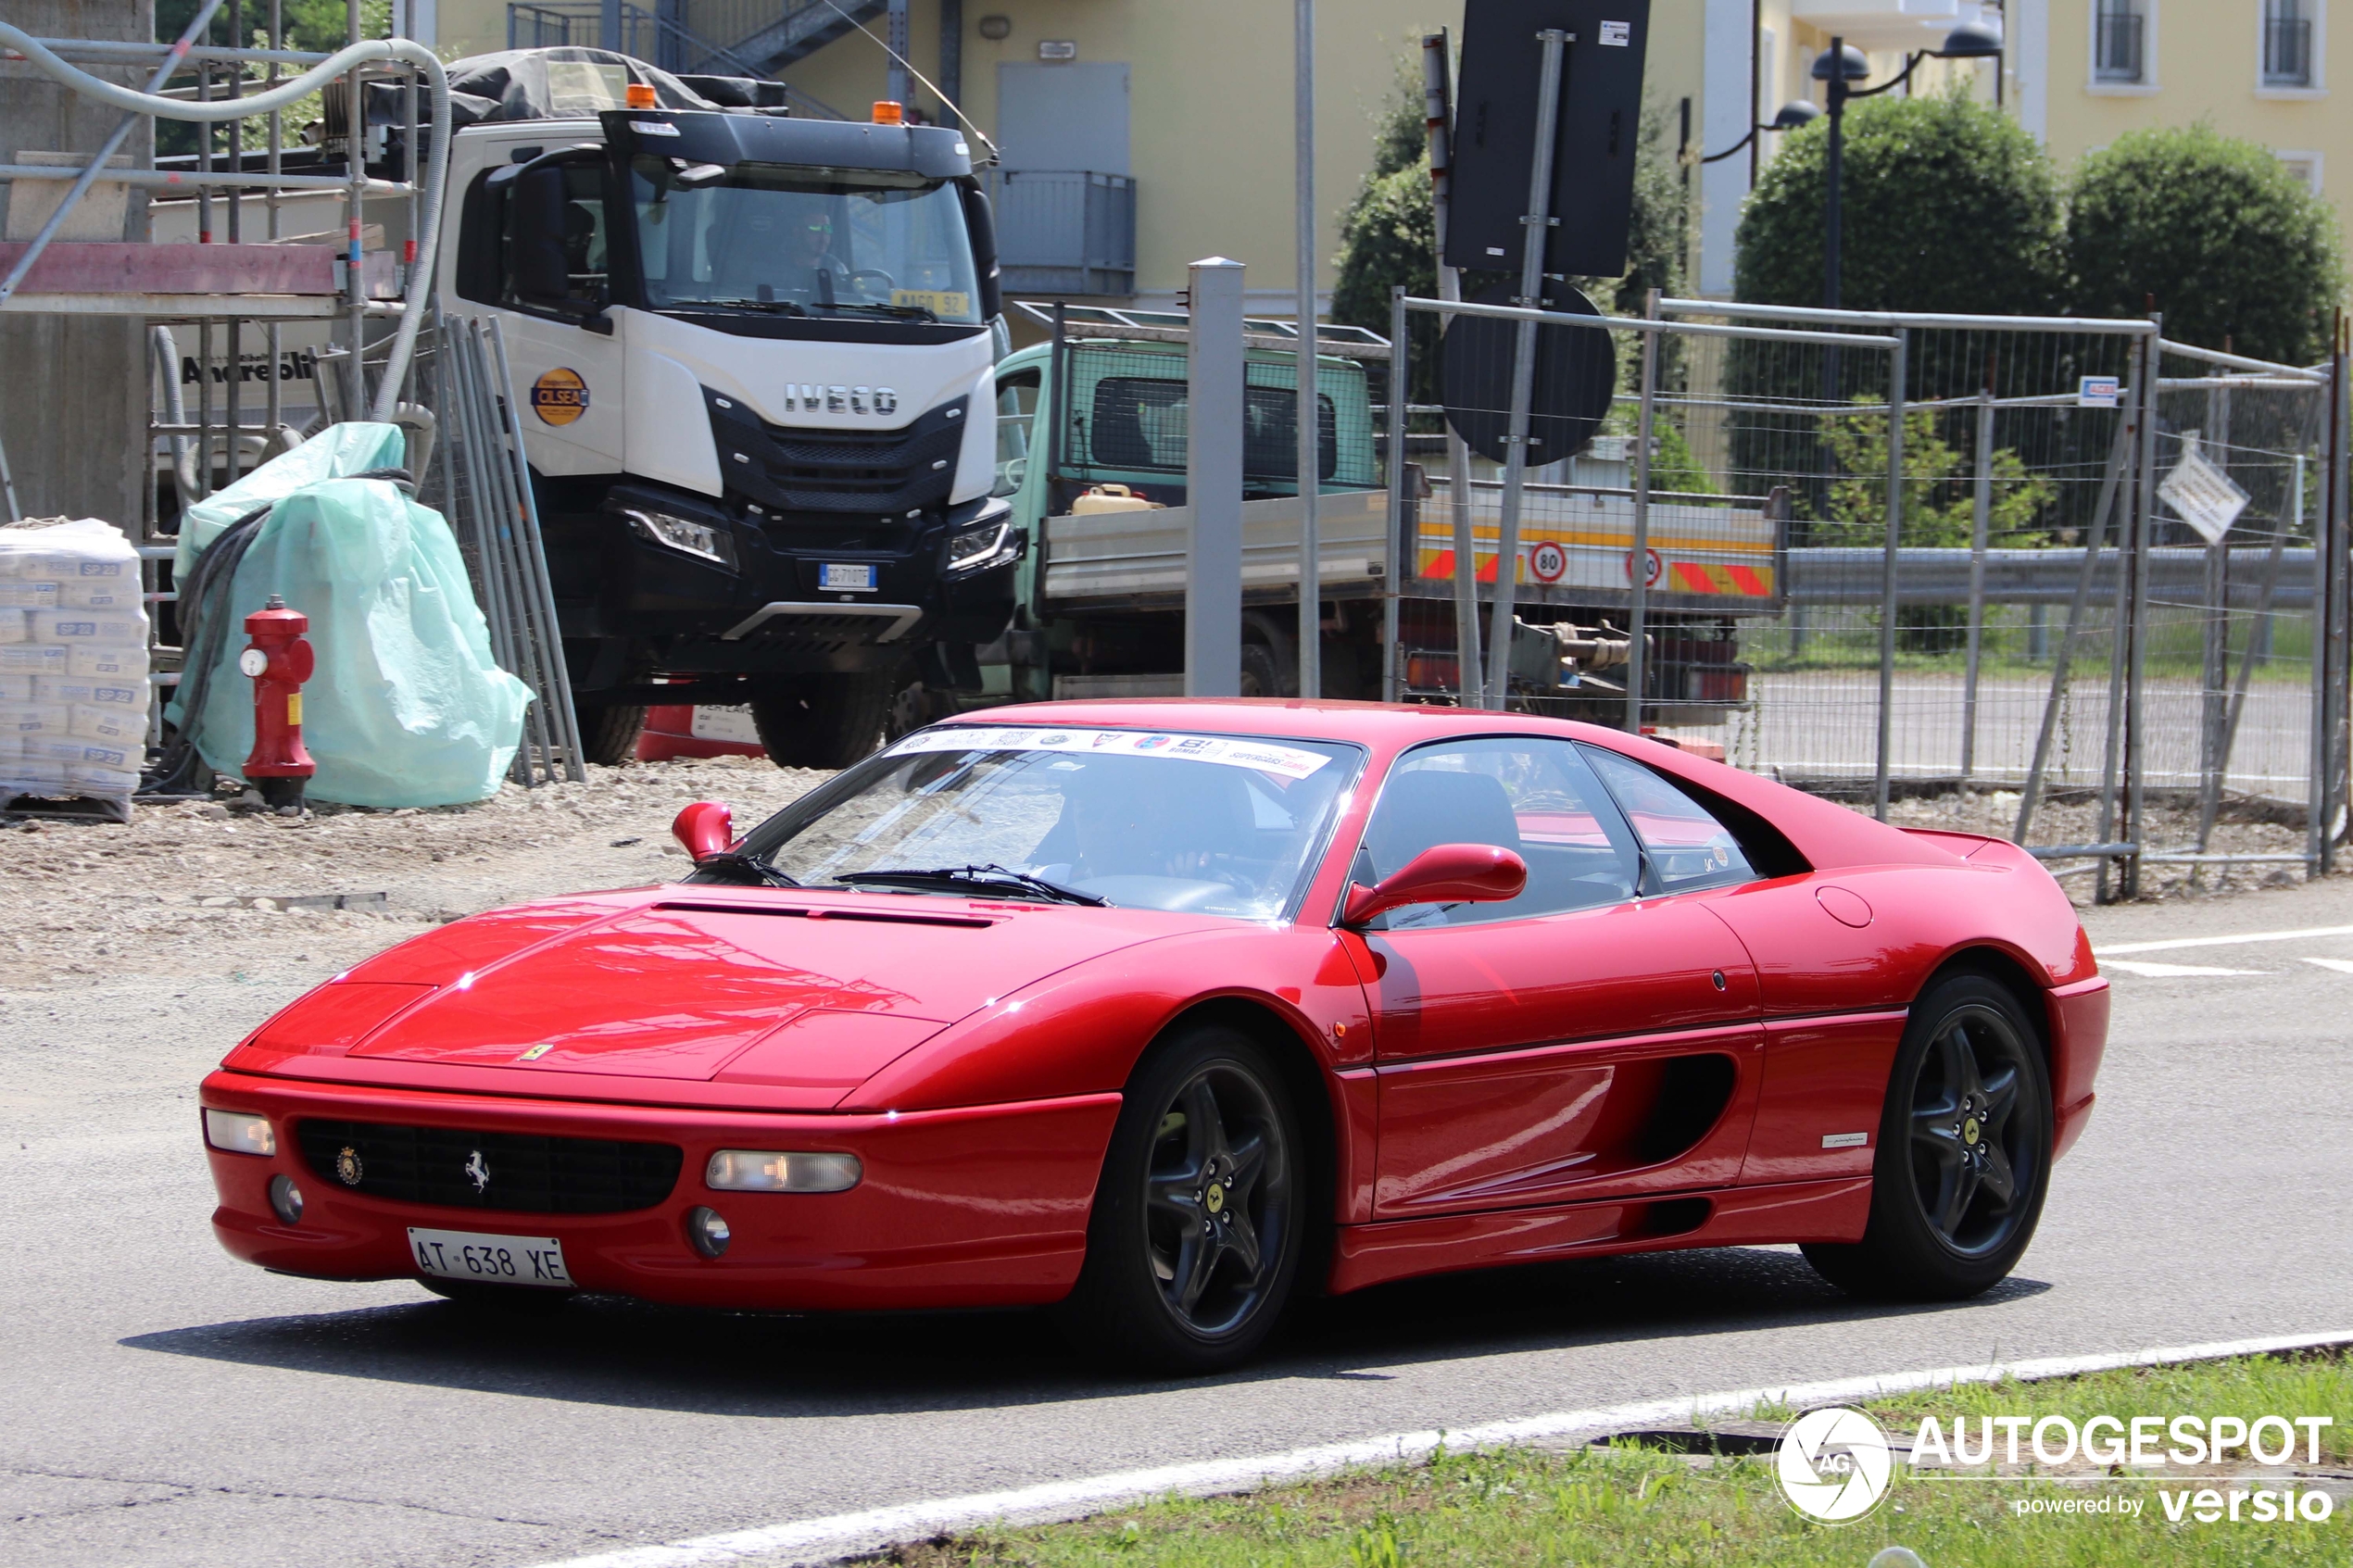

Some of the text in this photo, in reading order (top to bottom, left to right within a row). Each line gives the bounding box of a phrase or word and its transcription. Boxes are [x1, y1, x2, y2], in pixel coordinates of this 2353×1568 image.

[785, 383, 898, 416] IVECO
[84, 564, 100, 575] SP
[102, 565, 117, 575] 22
[1540, 554, 1558, 571] 80
[59, 624, 75, 635] SP
[98, 689, 115, 700] SP
[115, 691, 130, 702] 22
[88, 748, 104, 760] SP
[106, 751, 120, 764] 22
[1168, 746, 1202, 755] BOMBA
[417, 1240, 566, 1281] AT 638 XE
